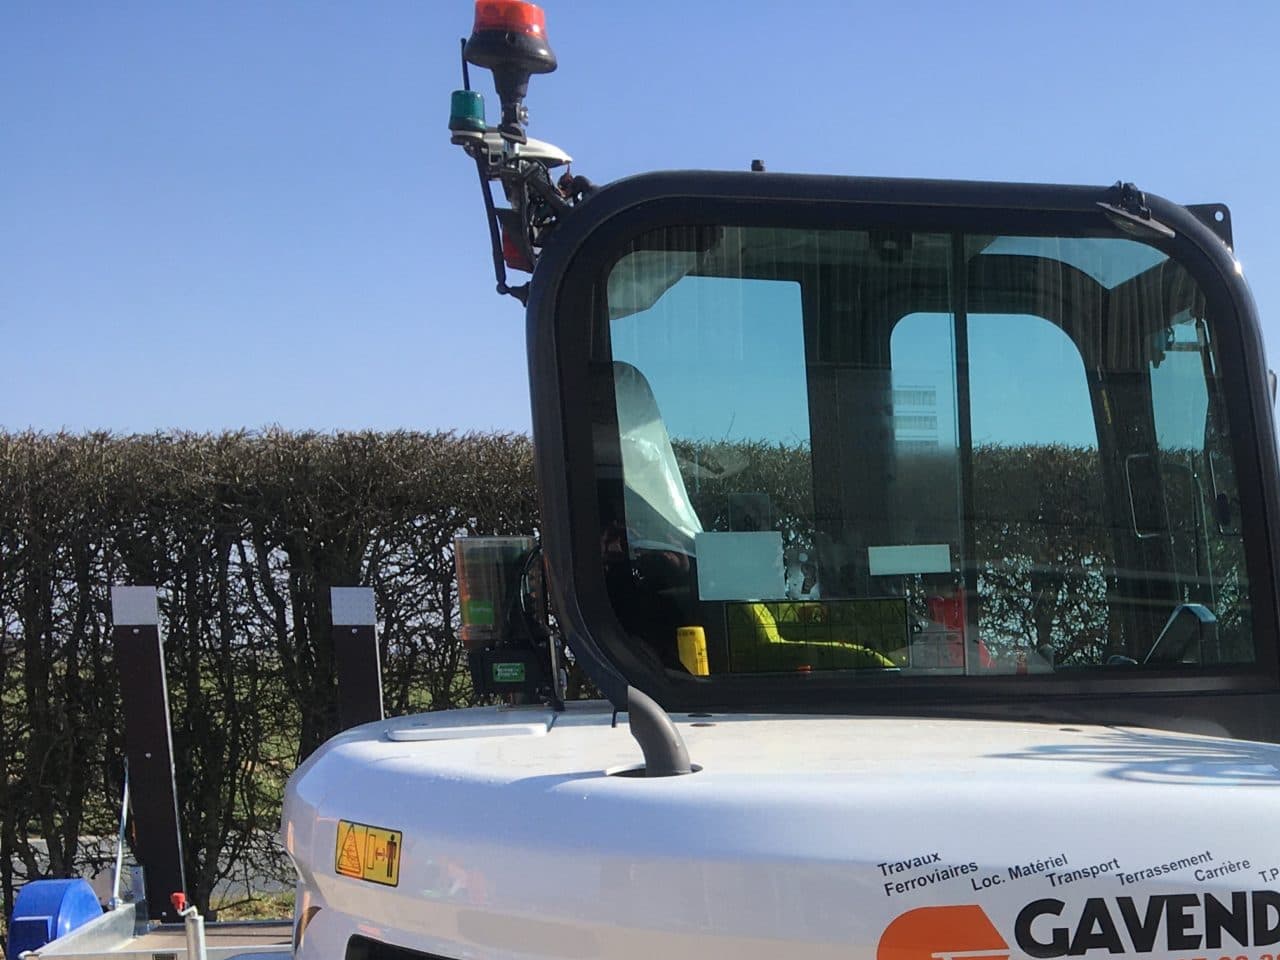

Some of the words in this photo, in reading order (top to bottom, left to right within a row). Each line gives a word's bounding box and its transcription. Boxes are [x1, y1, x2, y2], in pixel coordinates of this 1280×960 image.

[877, 852, 942, 877] Travaux
[884, 861, 979, 897] Ferroviaires
[971, 873, 1006, 892] Loc.
[1008, 854, 1069, 880] Matériel
[1045, 858, 1121, 888] Transport
[1116, 850, 1214, 886] Terrassement
[1194, 858, 1251, 883] Carrière
